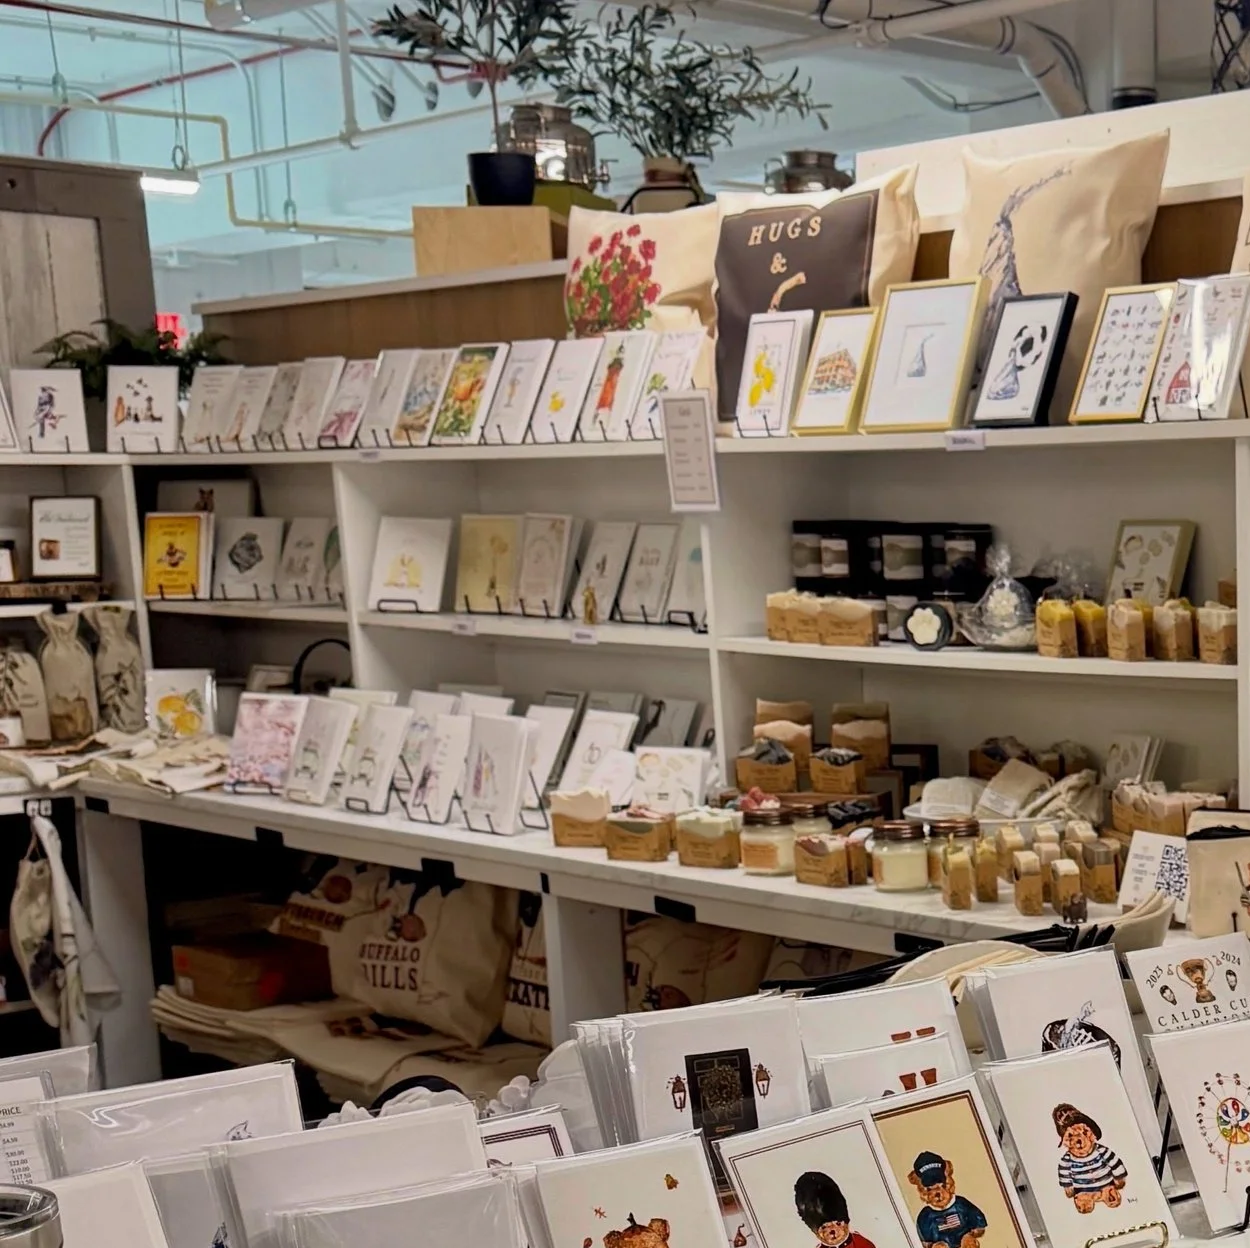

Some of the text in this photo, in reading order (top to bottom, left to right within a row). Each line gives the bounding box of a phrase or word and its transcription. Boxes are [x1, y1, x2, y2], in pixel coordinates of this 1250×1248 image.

[747, 215, 822, 247] HUGS
[770, 251, 787, 274] &
[1145, 950, 1242, 989] 2023 2024
[1157, 1002, 1222, 1028] CALDER
